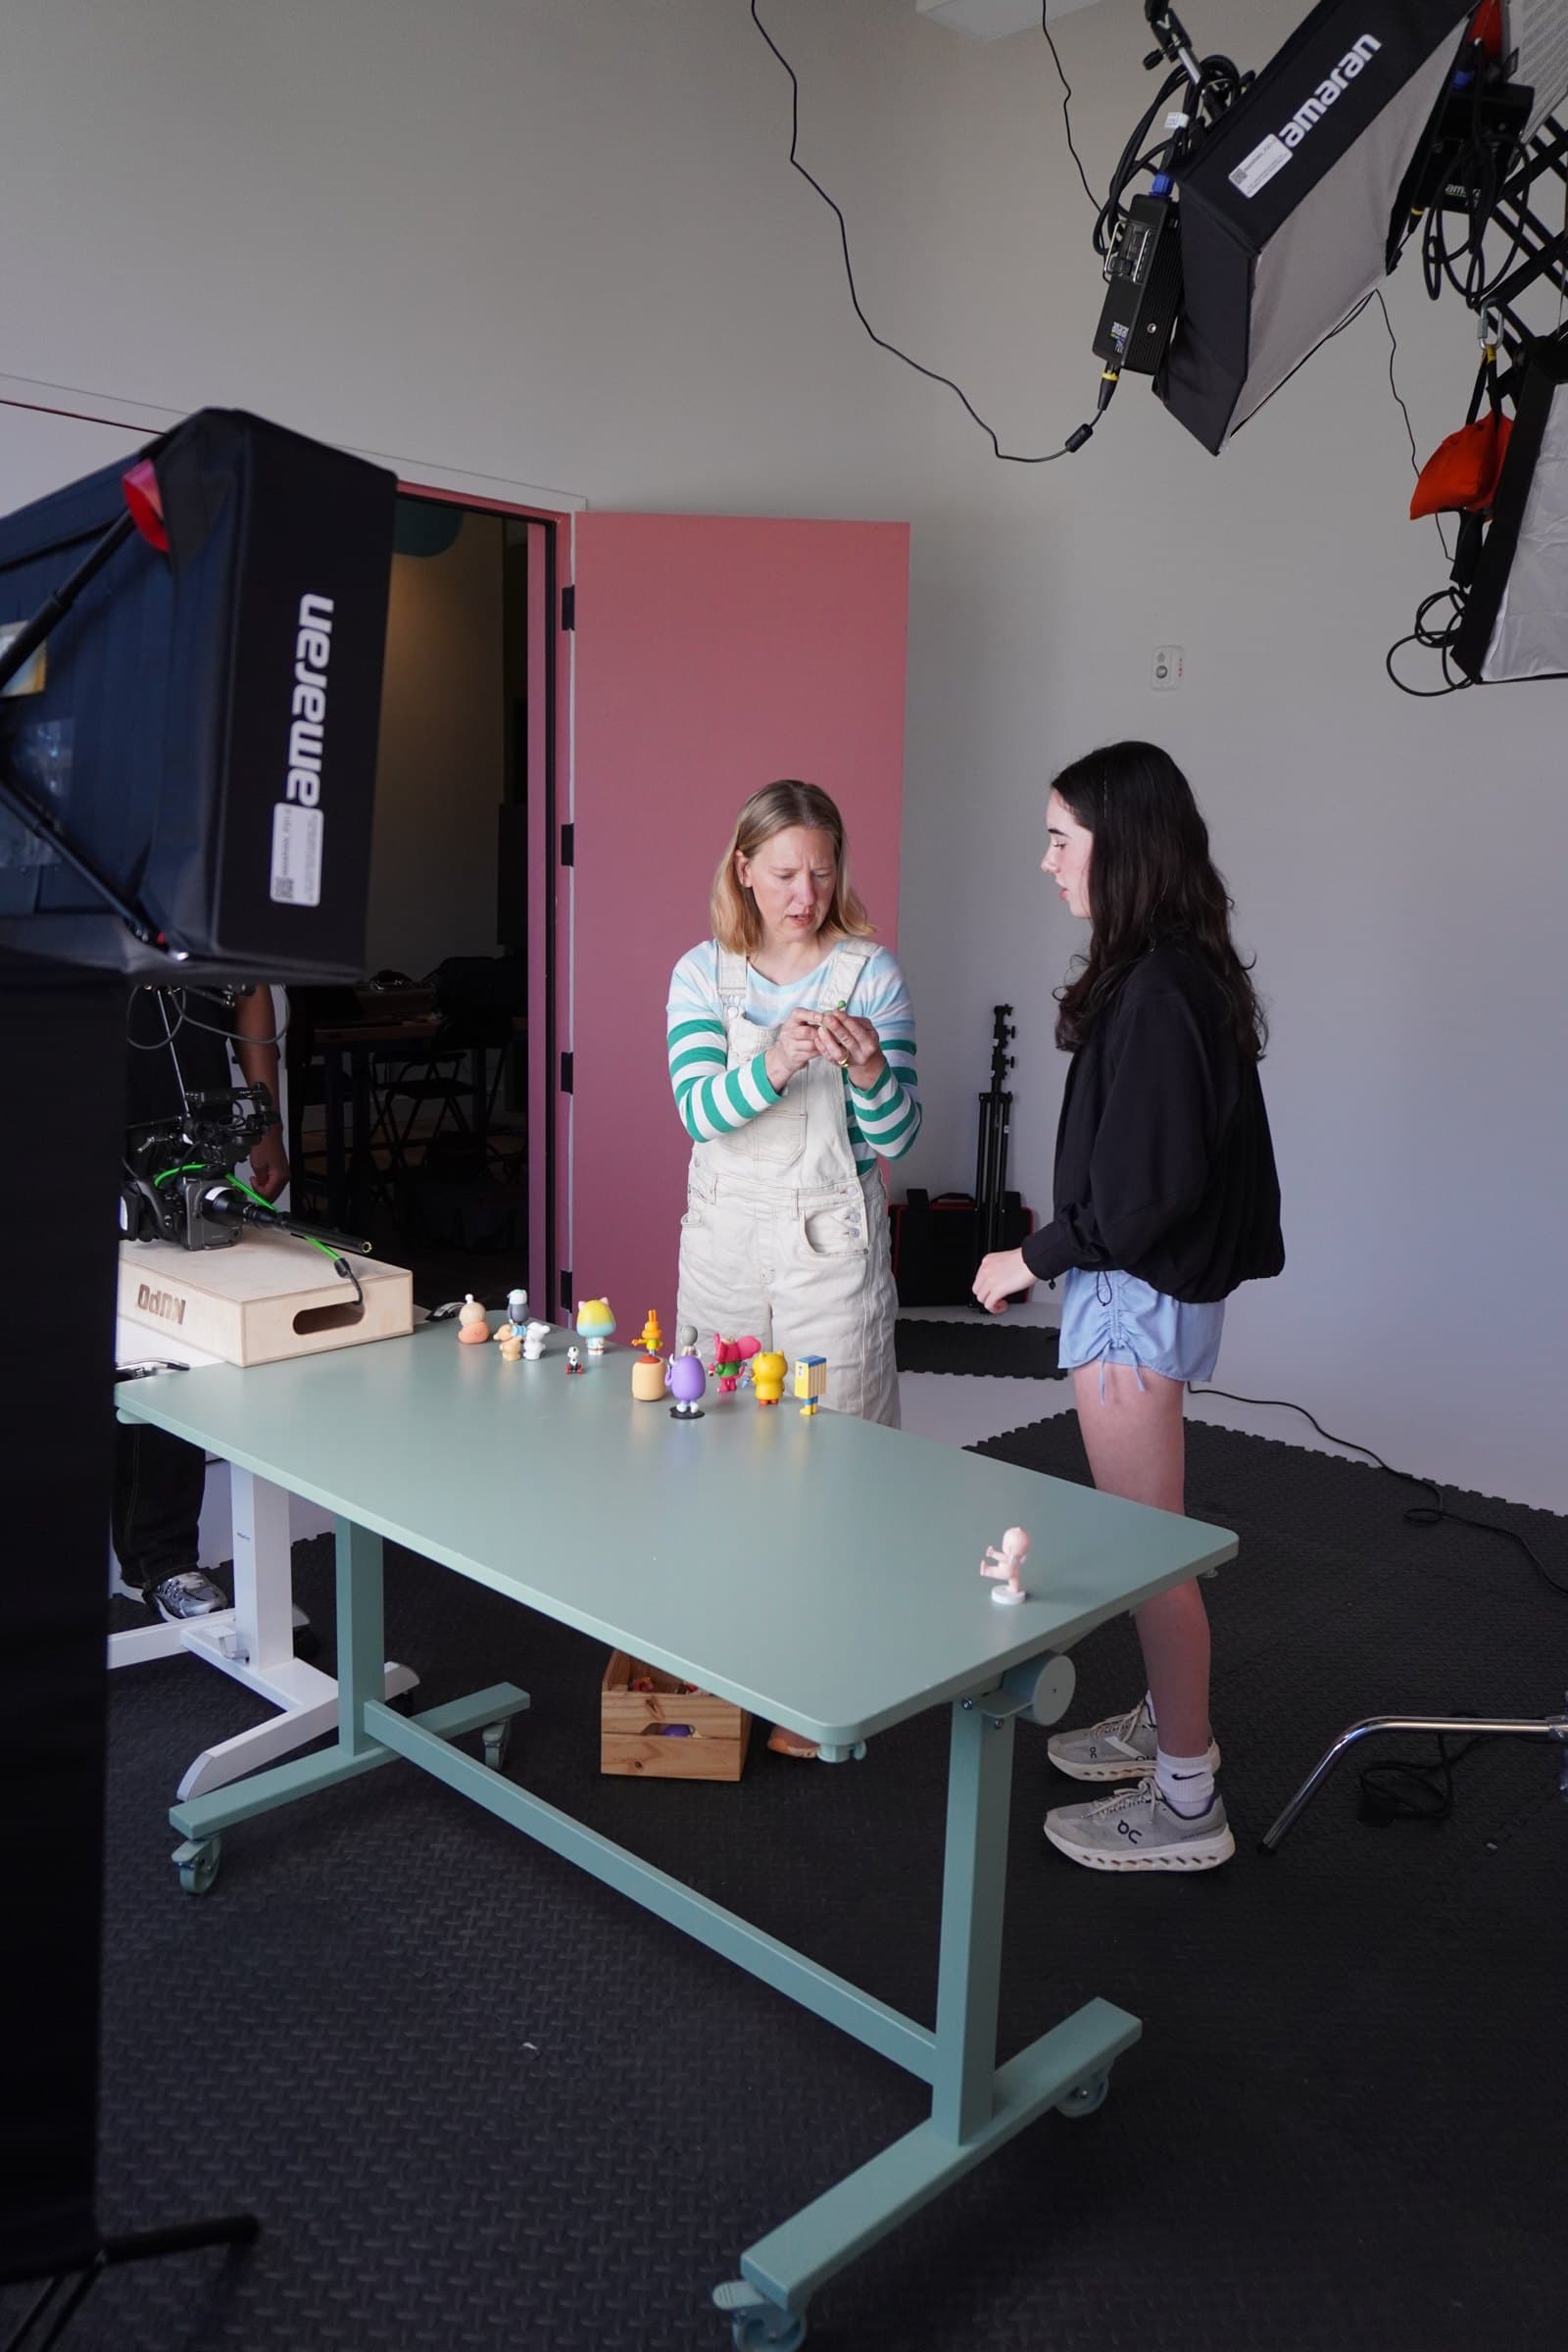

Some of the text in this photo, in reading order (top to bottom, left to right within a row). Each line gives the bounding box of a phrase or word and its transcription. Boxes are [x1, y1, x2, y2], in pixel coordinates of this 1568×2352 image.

[1279, 33, 1382, 148] amaran
[287, 593, 333, 808] amaran
[138, 1284, 186, 1325] KUPO
